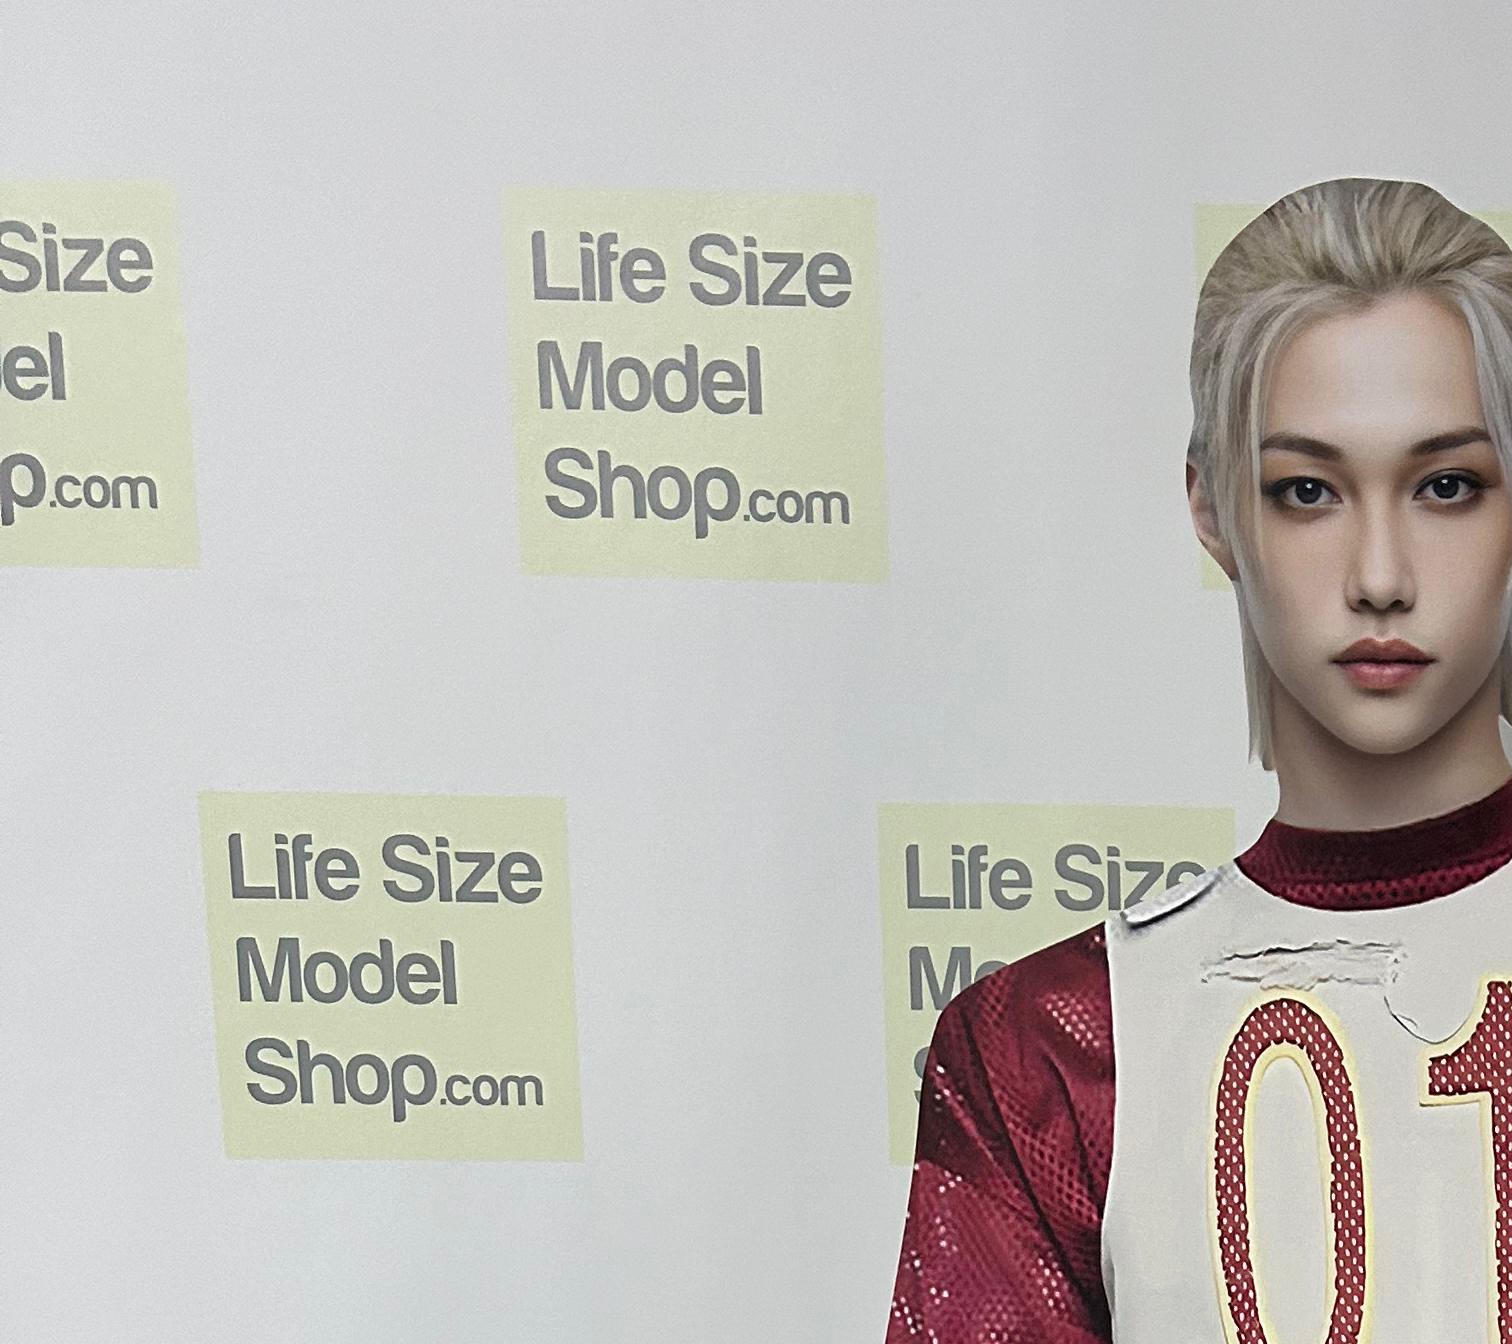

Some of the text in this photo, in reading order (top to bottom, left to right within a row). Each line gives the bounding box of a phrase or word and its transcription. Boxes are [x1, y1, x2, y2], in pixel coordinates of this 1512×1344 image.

[0, 221, 153, 293] Size
[532, 231, 852, 308] Life Size
[538, 341, 762, 415] Model
[0, 453, 158, 526] p.com
[545, 448, 850, 539] Shop.com
[228, 833, 542, 904] Life Size
[906, 844, 1032, 910] Life
[236, 937, 457, 1005] Model
[245, 1038, 543, 1122] Shop.com
